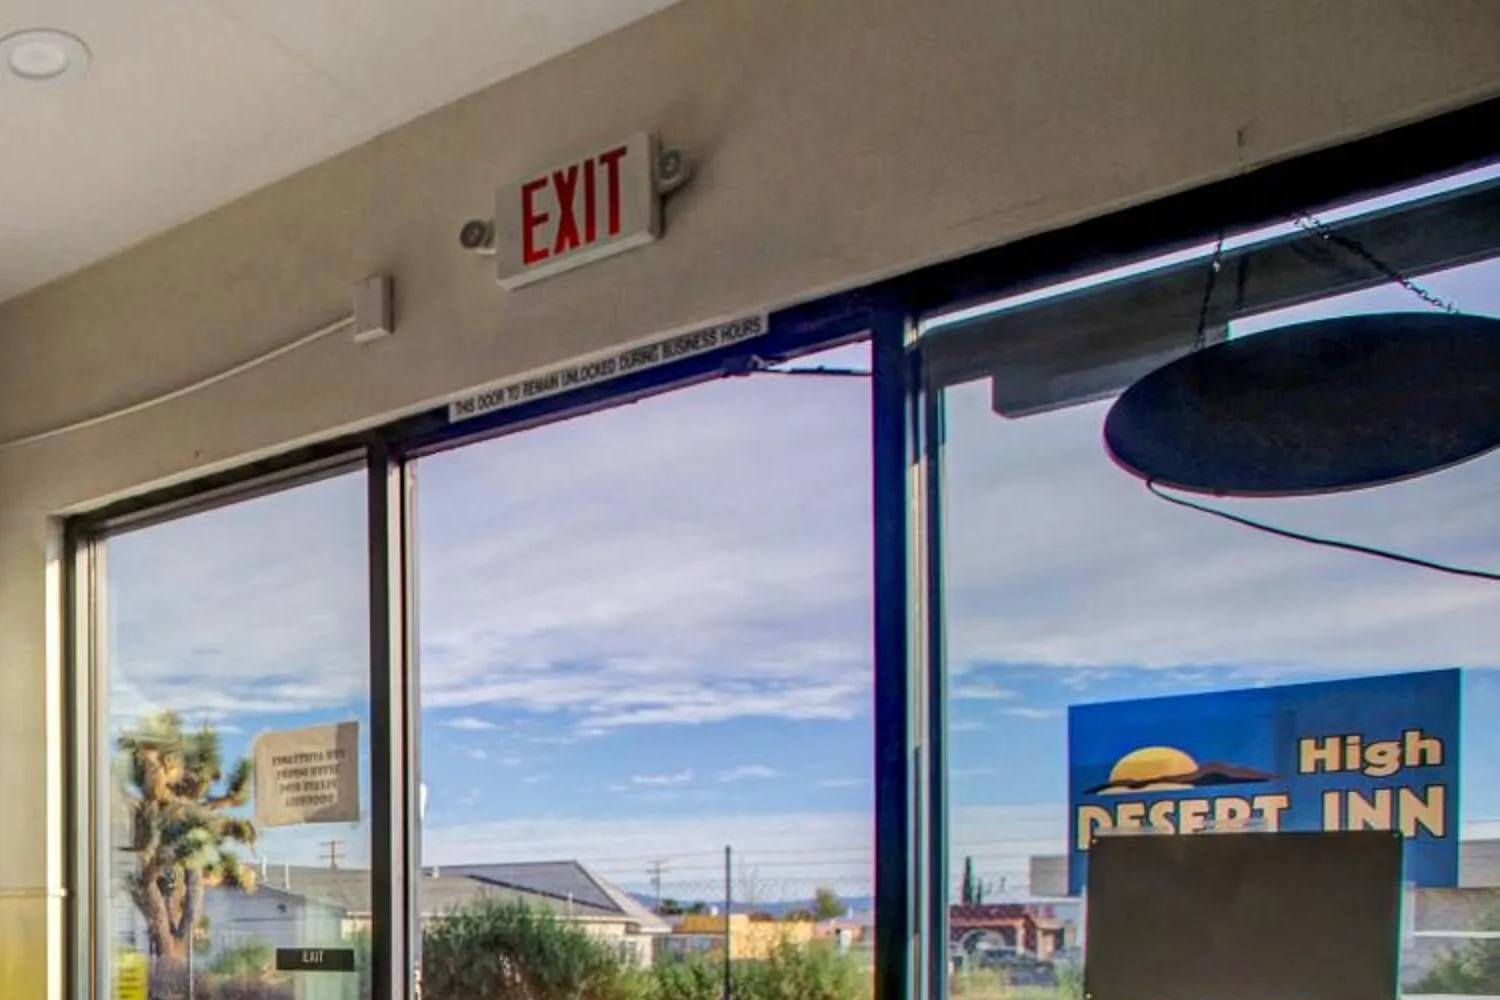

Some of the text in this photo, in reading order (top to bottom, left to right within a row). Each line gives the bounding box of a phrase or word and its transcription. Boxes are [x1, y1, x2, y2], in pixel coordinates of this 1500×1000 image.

[521, 144, 628, 266] EXIT
[455, 315, 762, 416] THIS DOOR TO REMAIN UNLOCKED DURING BUSINESS HOURS
[1297, 728, 1444, 779] High
[1075, 782, 1445, 851] DESERT INN
[301, 949, 325, 965] EXIT
